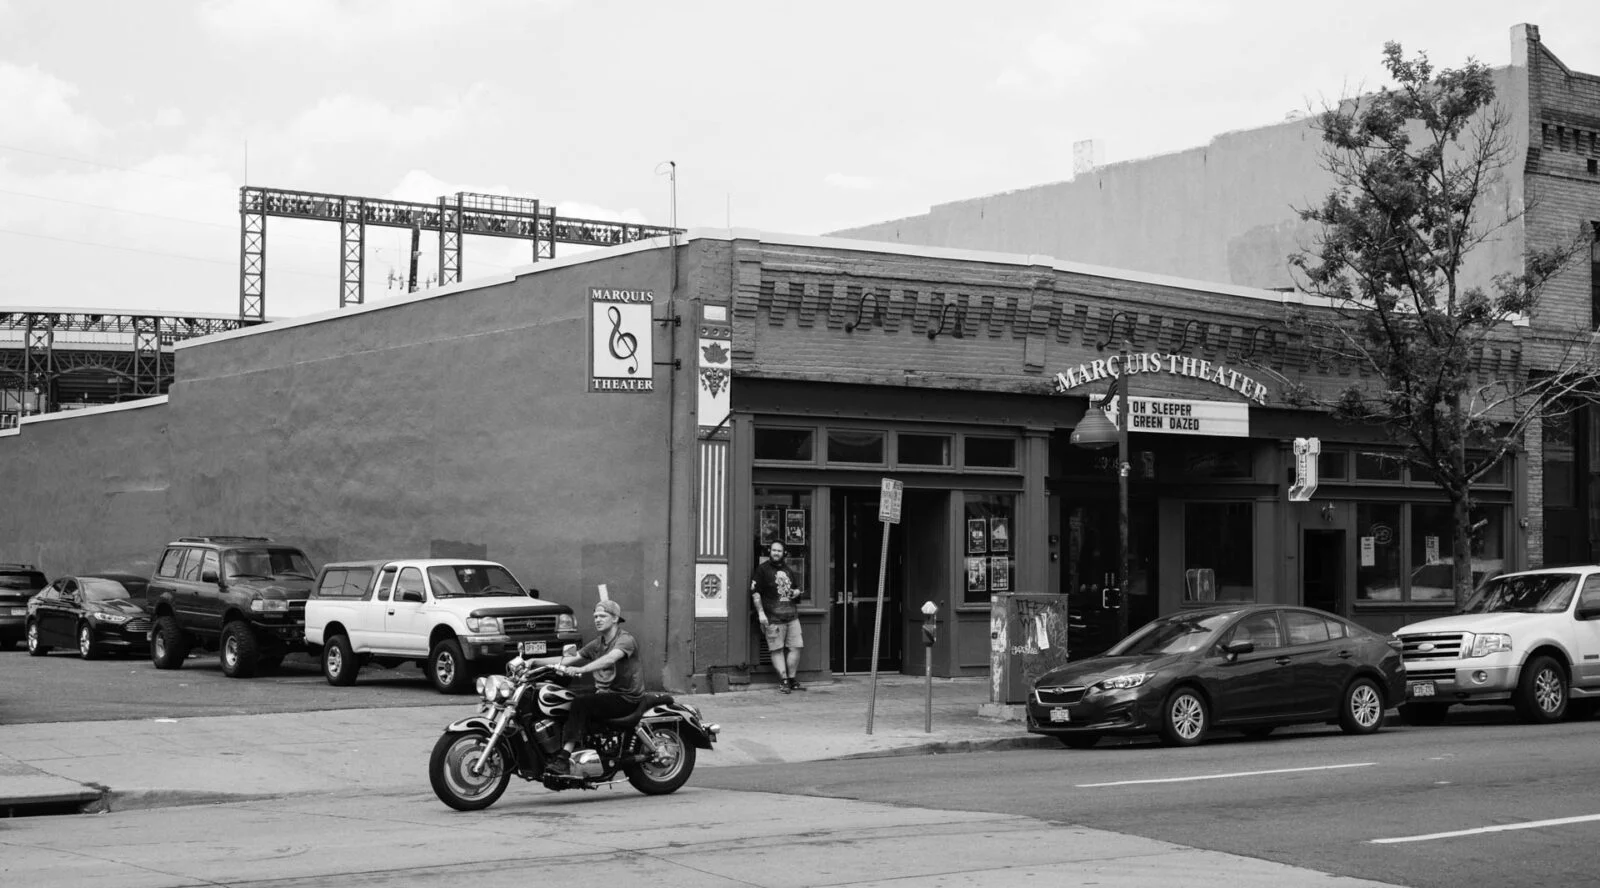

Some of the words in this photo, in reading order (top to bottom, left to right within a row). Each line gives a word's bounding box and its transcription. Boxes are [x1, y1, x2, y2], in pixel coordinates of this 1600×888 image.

[592, 289, 653, 303] MARQUIS
[592, 379, 653, 390] THEATER
[1056, 352, 1161, 393] MARQUIS
[1166, 353, 1268, 406] THEATER
[1133, 401, 1146, 414] OH
[1152, 402, 1192, 416] SLEEPER
[1133, 415, 1163, 428] GREEN
[1169, 417, 1200, 431] DAZED
